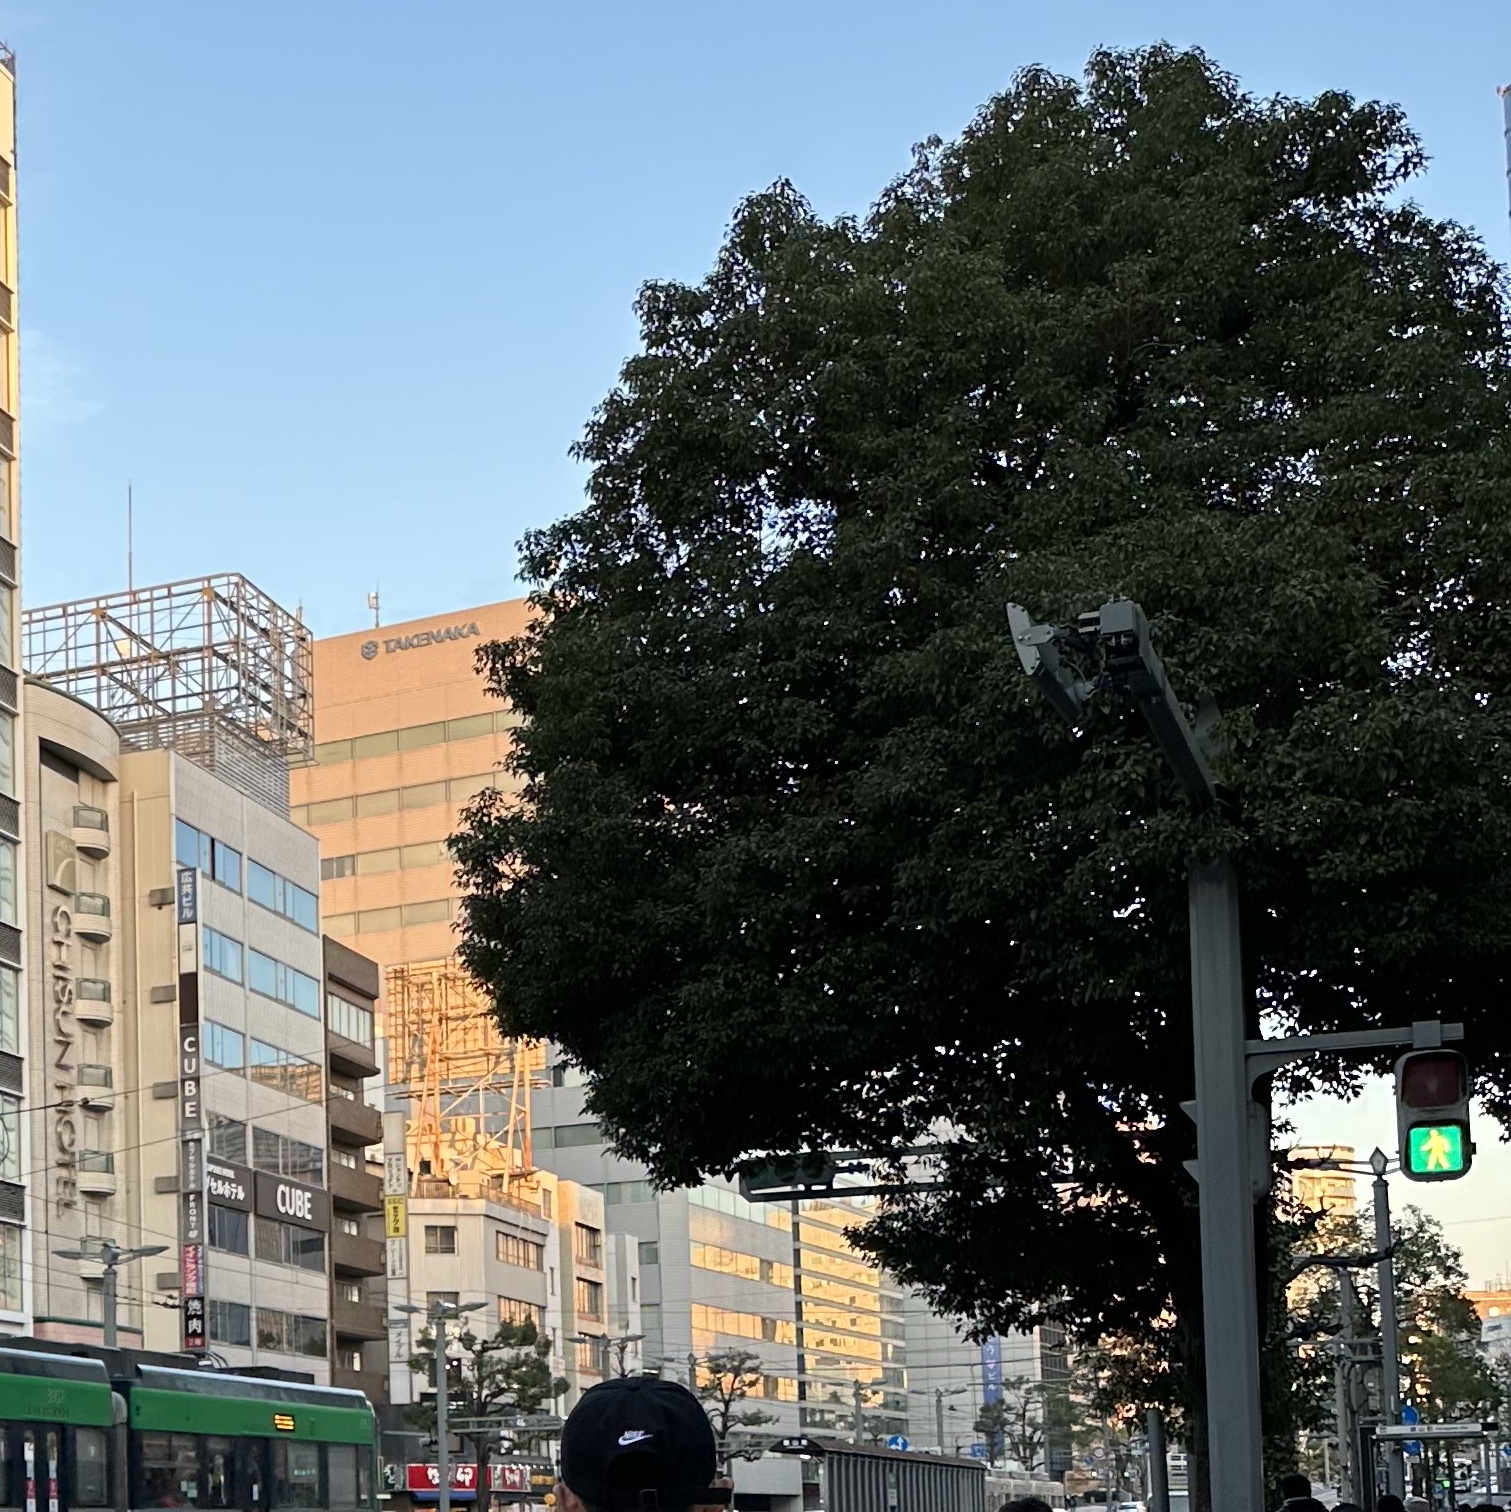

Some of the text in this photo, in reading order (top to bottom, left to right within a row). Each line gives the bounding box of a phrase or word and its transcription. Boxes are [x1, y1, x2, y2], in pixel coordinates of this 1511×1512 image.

[382, 621, 481, 654] TAKENAKA
[183, 1036, 197, 1118] CUBE
[276, 1184, 313, 1220] CUBE
